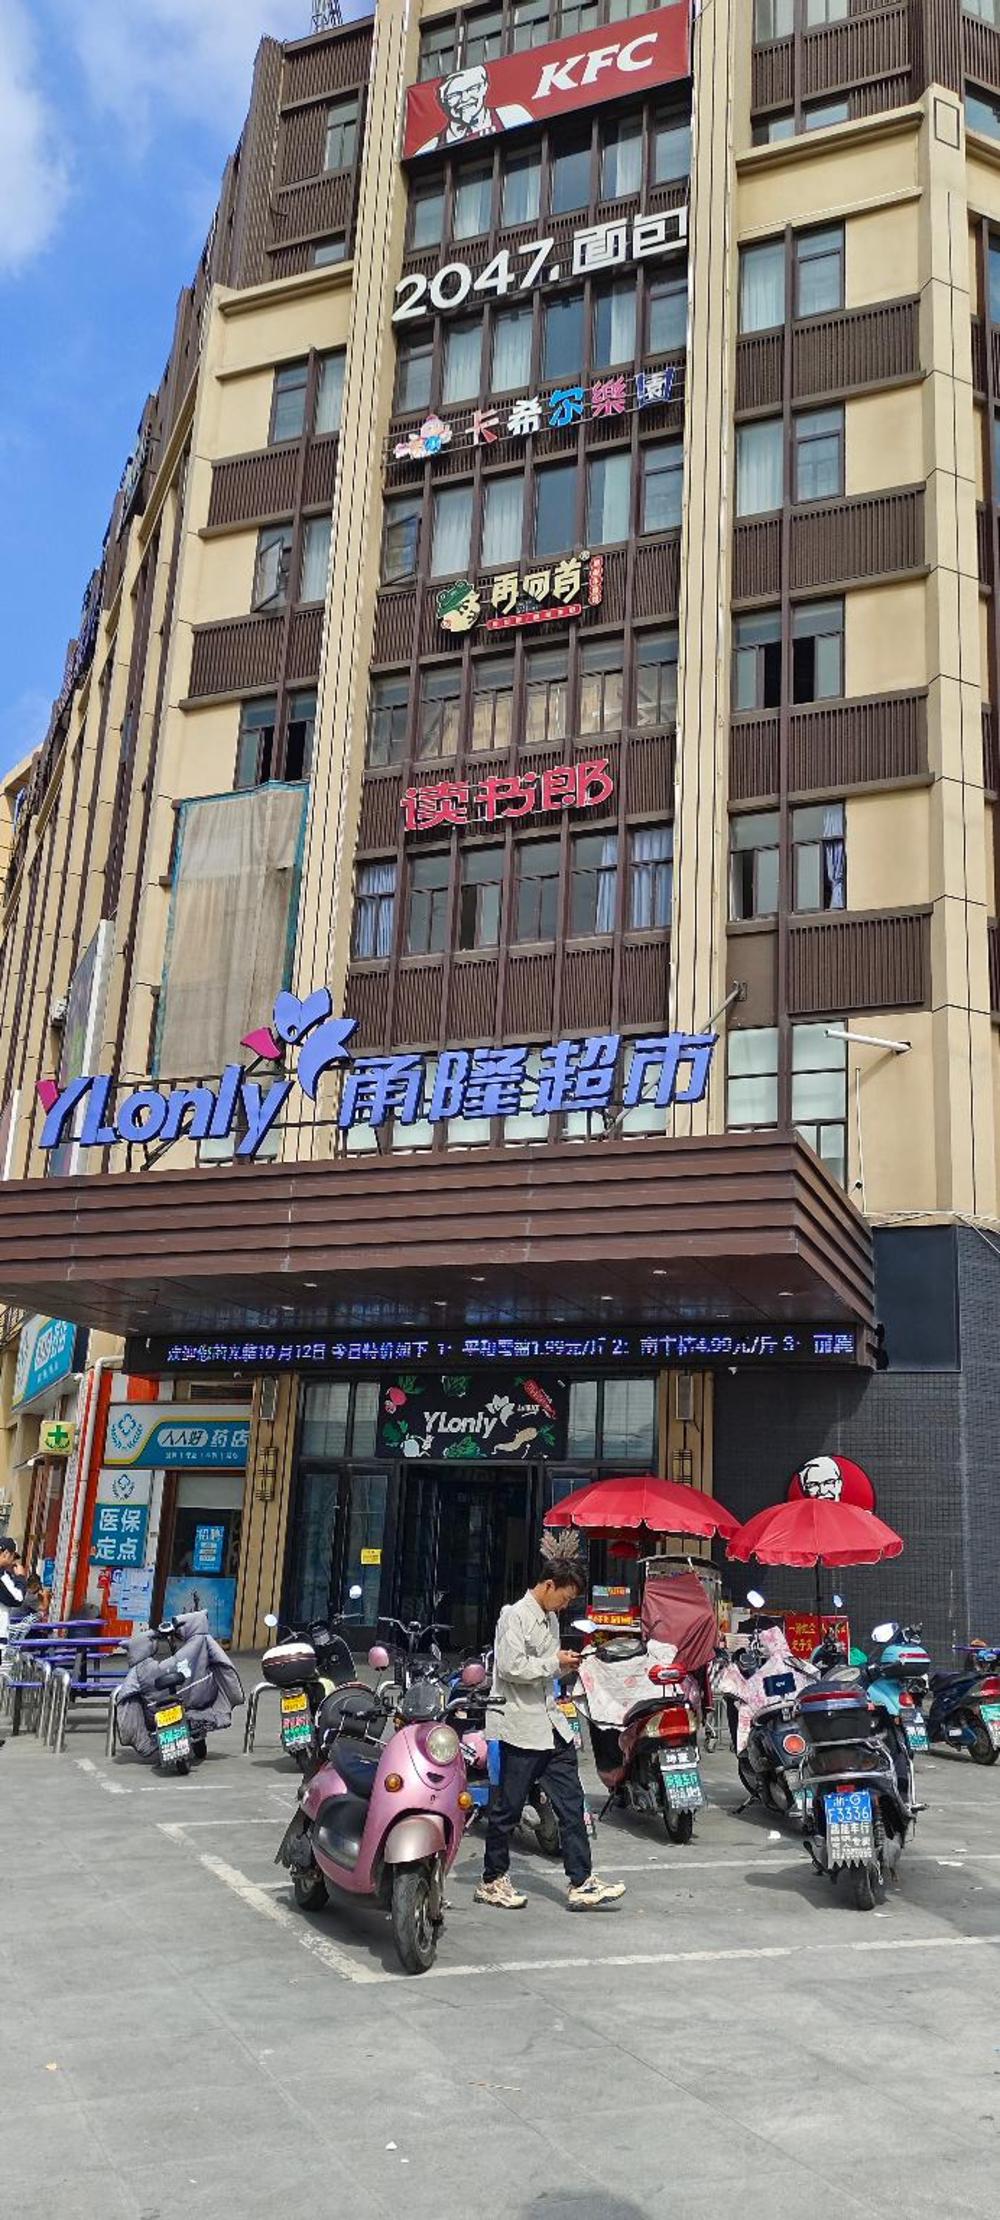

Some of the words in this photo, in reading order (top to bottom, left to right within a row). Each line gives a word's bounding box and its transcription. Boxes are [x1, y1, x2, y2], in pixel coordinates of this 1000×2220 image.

[531, 33, 658, 100] KFC
[401, 758, 614, 831] 读书郎
[35, 1062, 295, 1158] YLonly
[338, 1032, 718, 1130] 甬隆超市
[423, 1411, 498, 1439] YLonly
[100, 1508, 140, 1532] 医保
[95, 1536, 138, 1560] 定点
